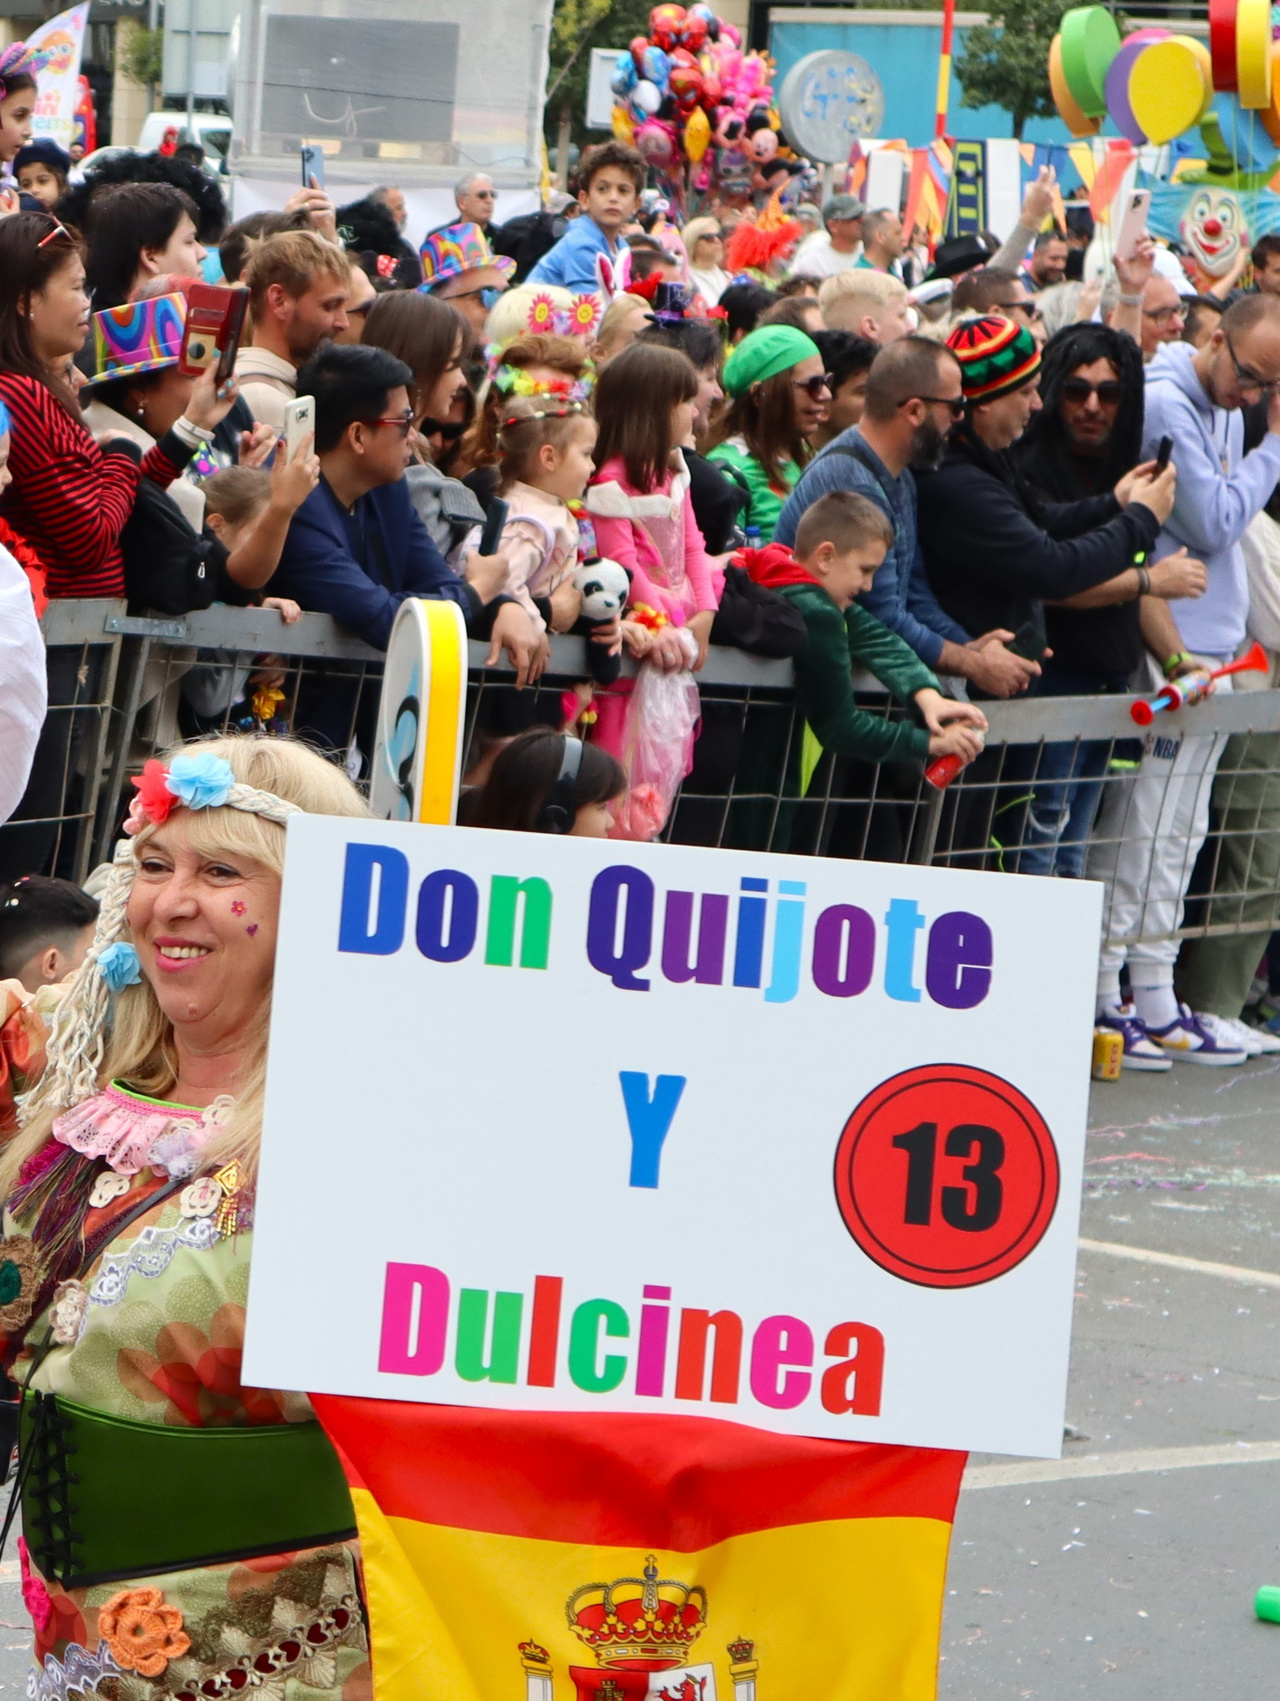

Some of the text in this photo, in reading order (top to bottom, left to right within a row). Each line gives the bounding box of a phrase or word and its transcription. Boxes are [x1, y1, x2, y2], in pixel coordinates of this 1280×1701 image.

[1153, 736, 1180, 759] NBA
[338, 842, 993, 1009] Don Quijote
[619, 1070, 686, 1189] Y
[892, 1121, 1005, 1232] 13
[378, 1262, 885, 1417] Dulcinea
